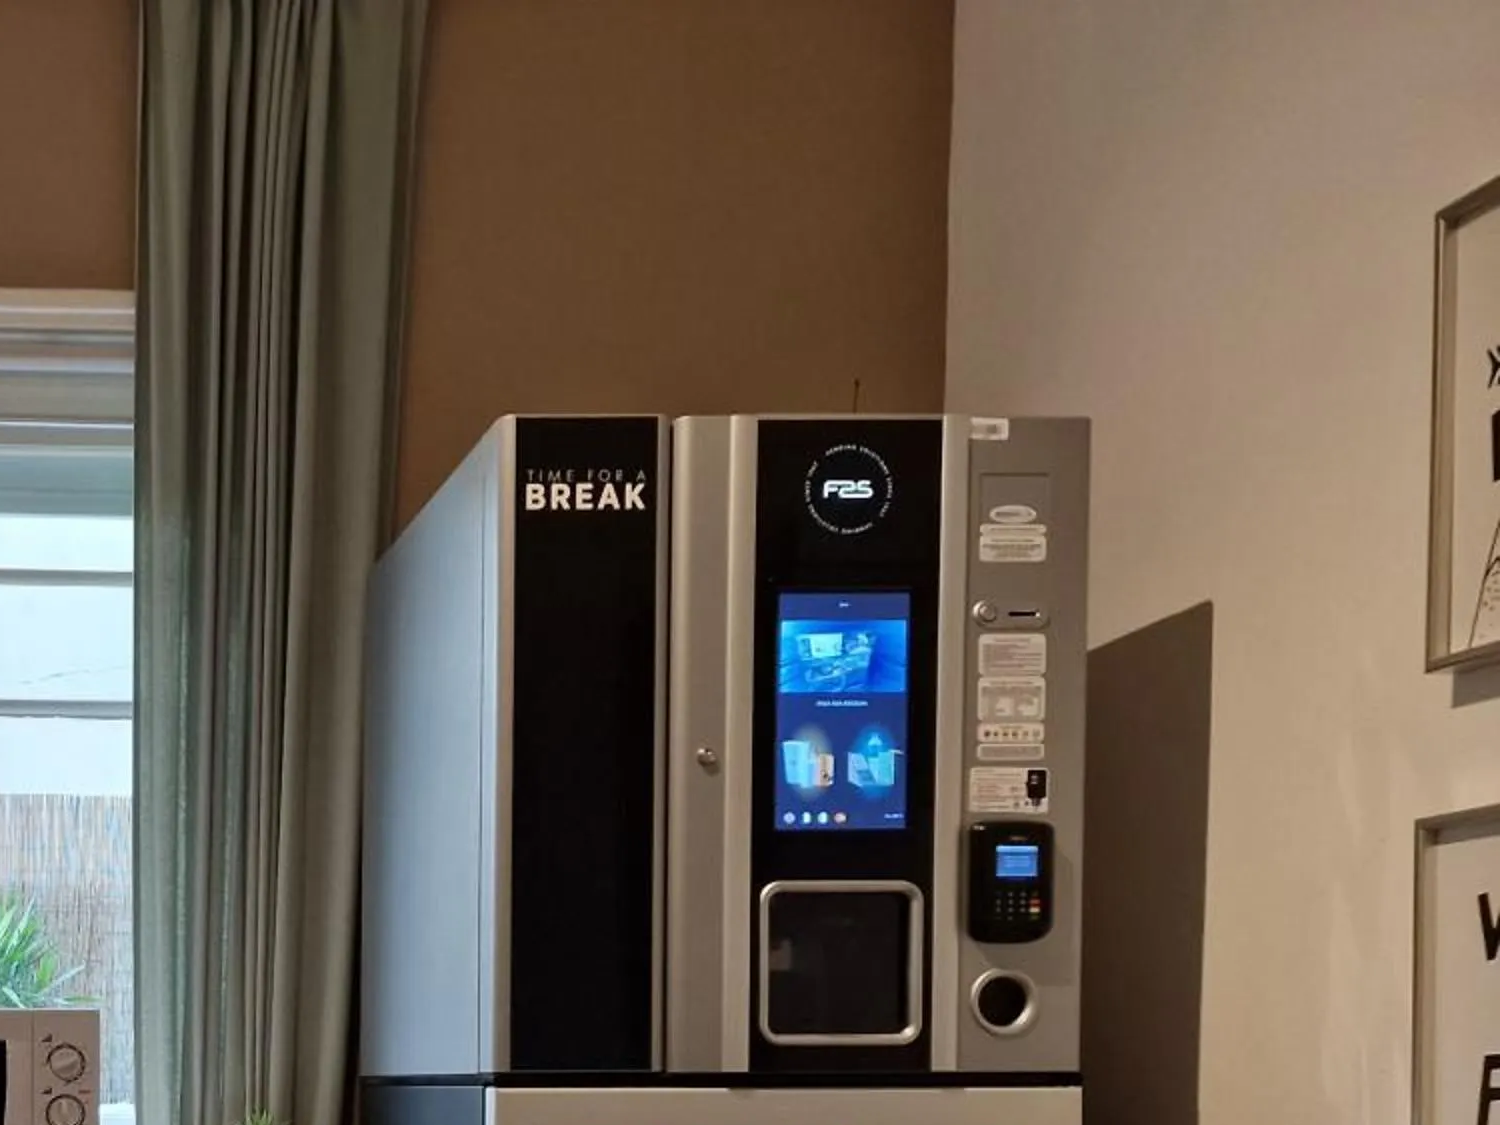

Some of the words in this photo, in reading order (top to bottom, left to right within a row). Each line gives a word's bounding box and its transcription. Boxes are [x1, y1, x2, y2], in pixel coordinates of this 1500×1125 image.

[527, 469, 575, 482] TIME
[587, 469, 623, 482] FOR
[636, 469, 647, 481] A
[525, 482, 646, 511] BREAK
